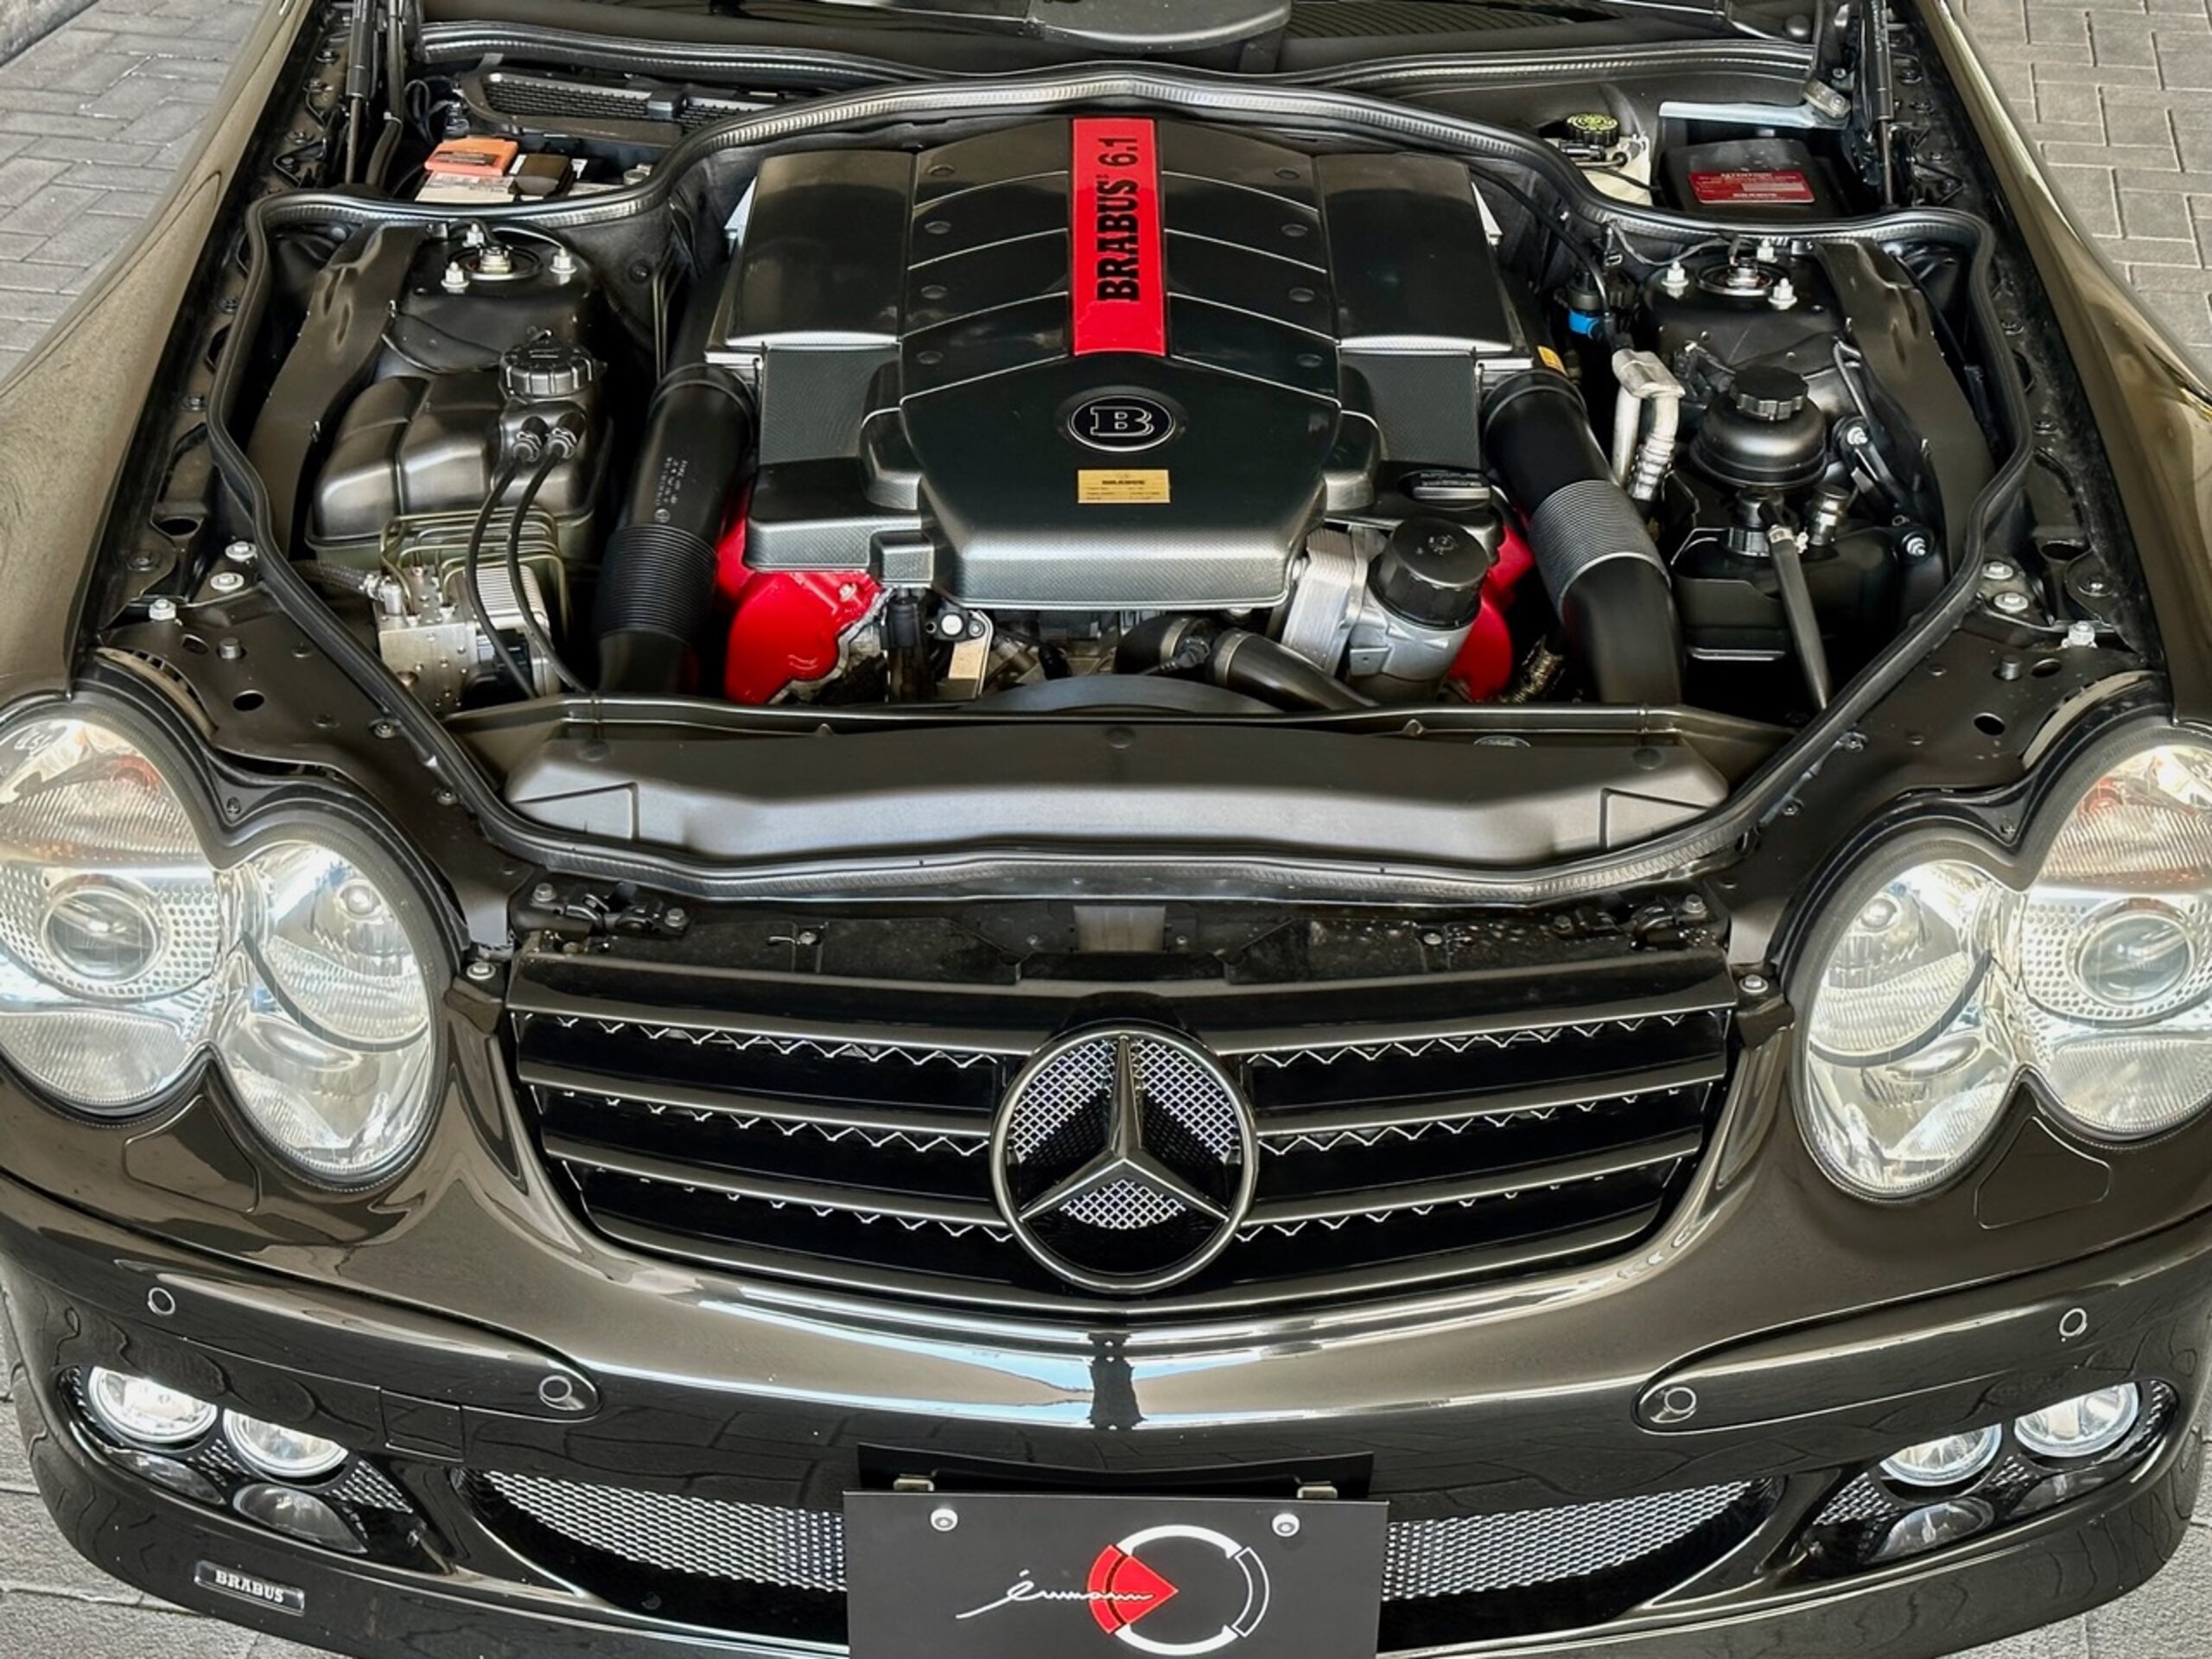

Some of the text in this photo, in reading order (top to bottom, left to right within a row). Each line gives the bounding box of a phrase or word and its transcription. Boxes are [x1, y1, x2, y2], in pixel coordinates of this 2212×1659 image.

[1096, 137, 1141, 302] BRABUS 6.1
[1090, 405, 1155, 437] B
[214, 1569, 285, 1604] BRABUS
